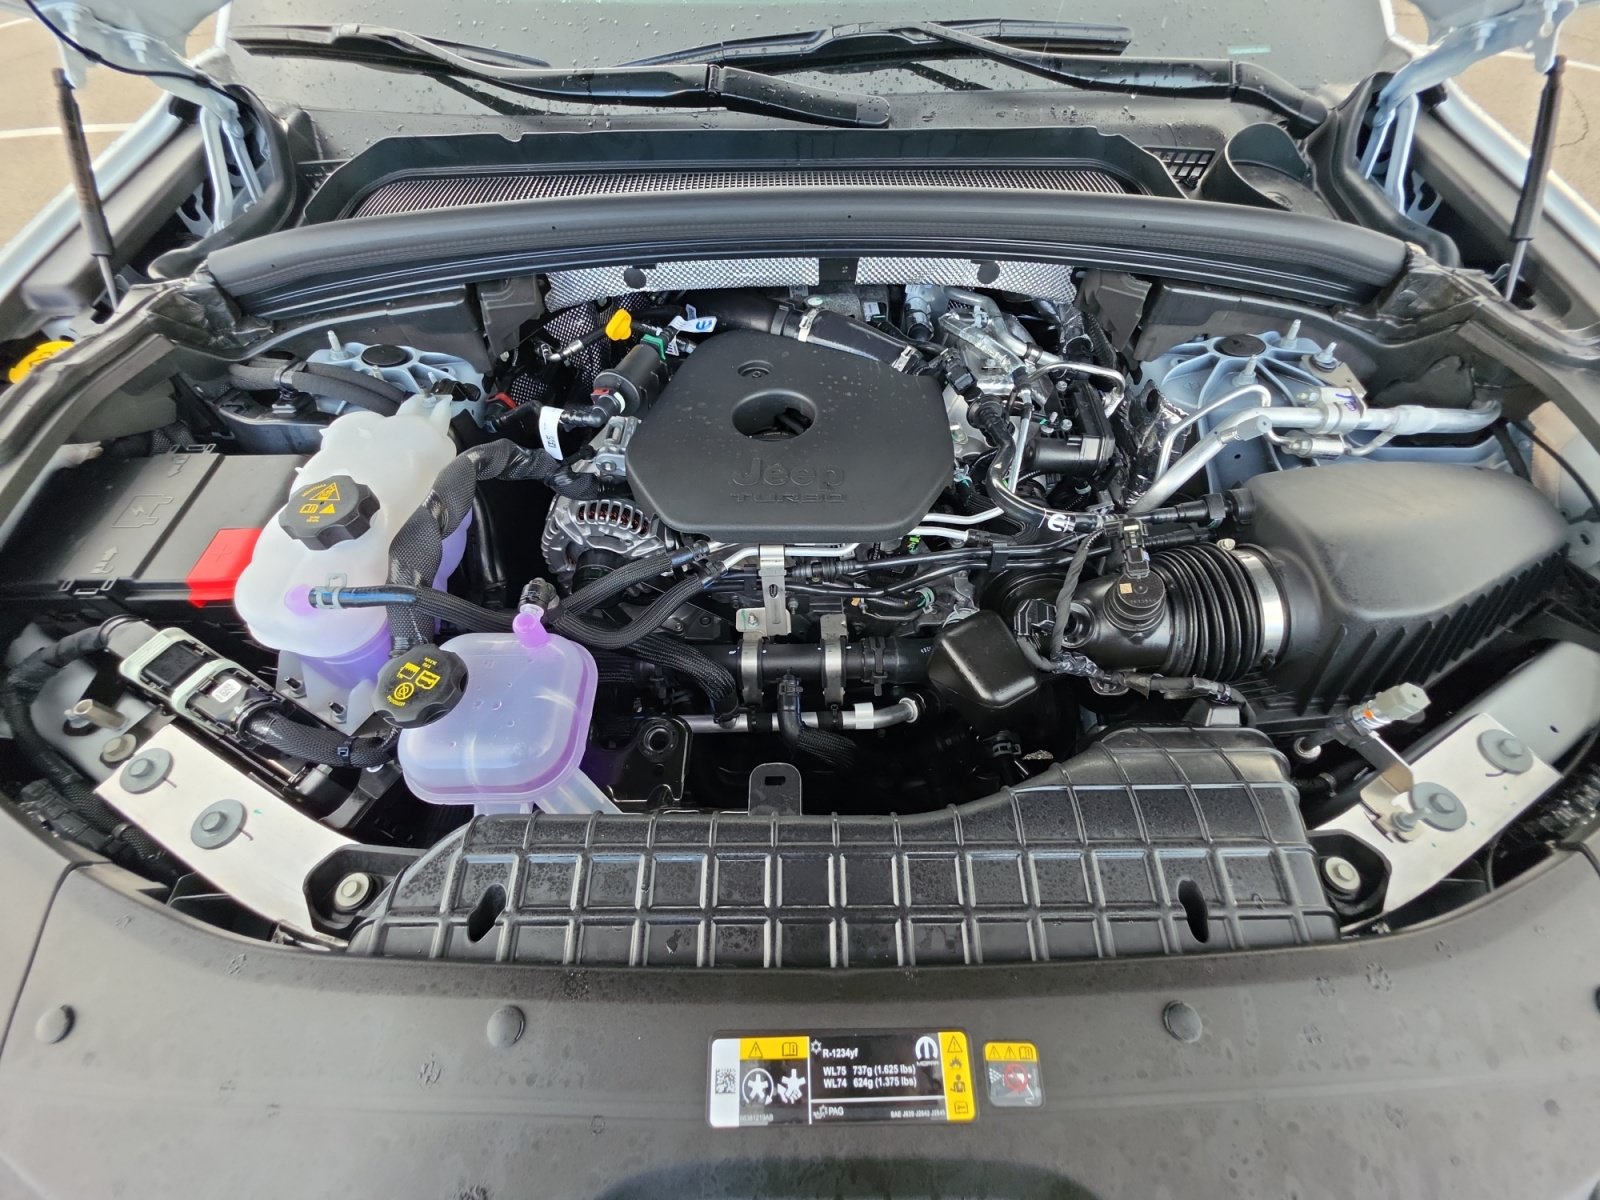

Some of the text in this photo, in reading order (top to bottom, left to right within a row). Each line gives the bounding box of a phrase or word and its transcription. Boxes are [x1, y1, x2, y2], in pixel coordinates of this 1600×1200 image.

[731, 456, 846, 493] Jeep
[730, 492, 847, 503] TURBO
[822, 1048, 859, 1060] R-1234yf
[823, 1063, 916, 1077] WL75 737g (1.625 lbs)
[824, 1076, 917, 1089] WL74 624g (1.375 lbs)
[828, 1106, 844, 1116] PAG
